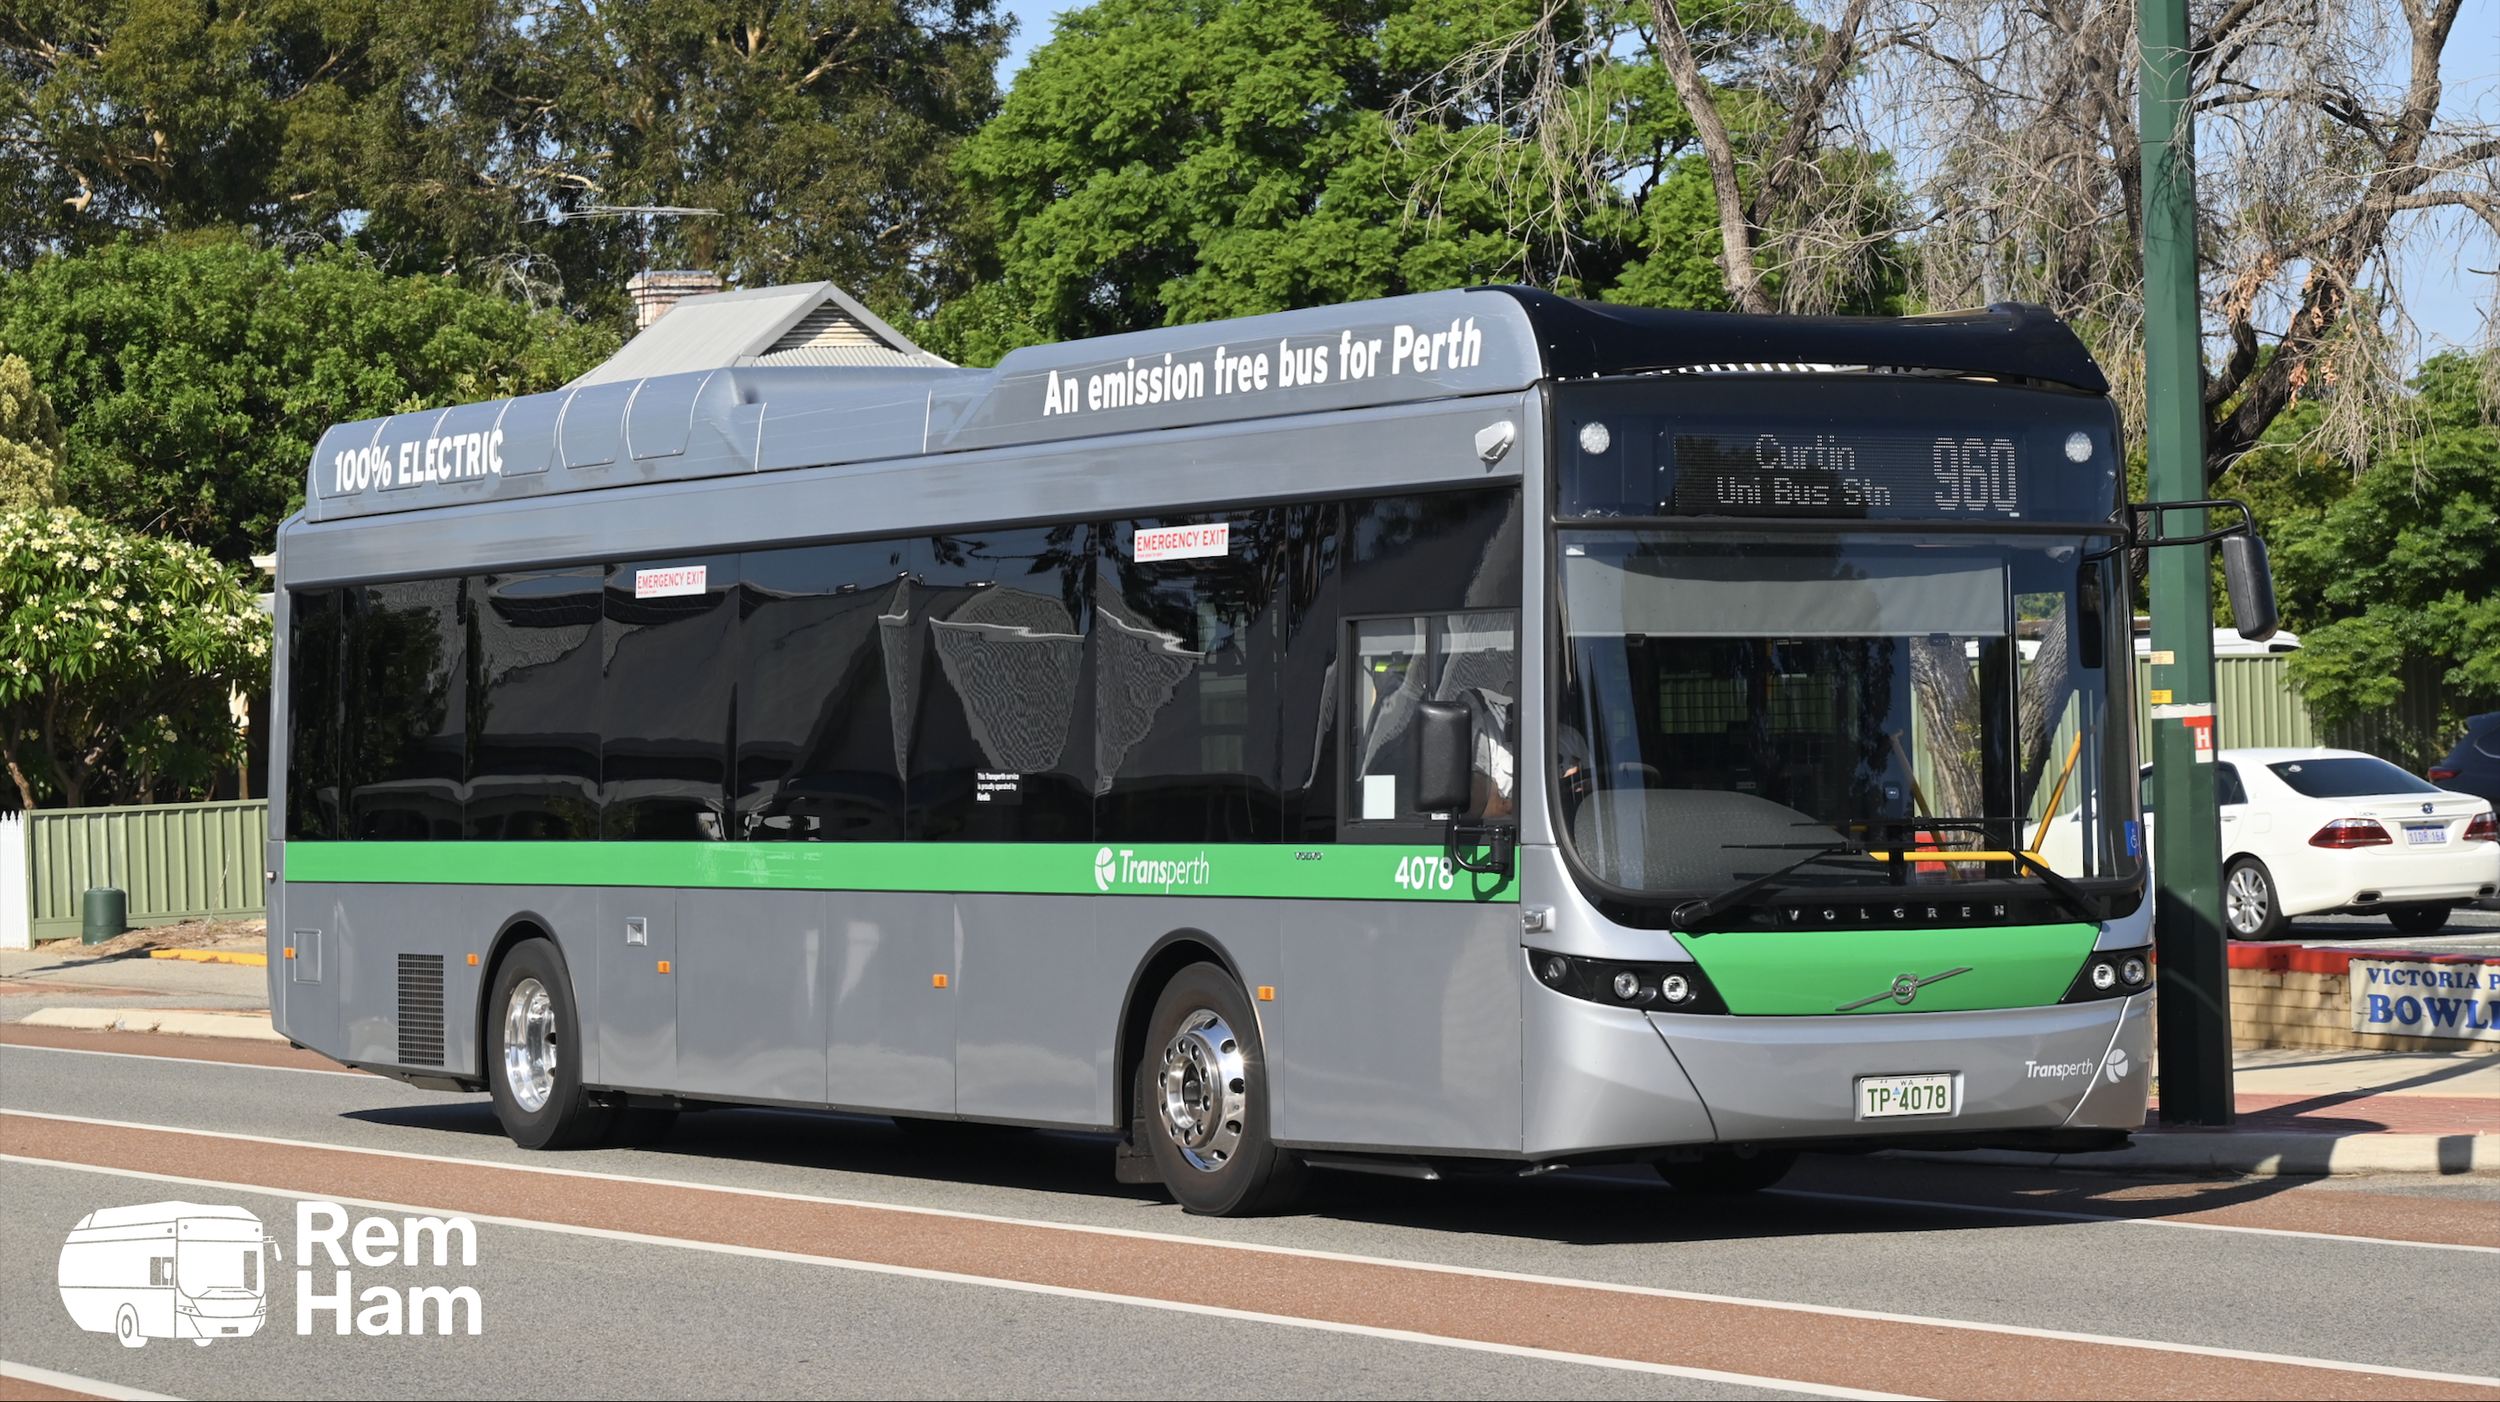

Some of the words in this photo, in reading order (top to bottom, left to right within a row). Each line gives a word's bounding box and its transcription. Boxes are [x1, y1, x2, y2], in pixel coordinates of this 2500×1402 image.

[1043, 370, 1079, 416] An
[1088, 353, 1204, 411] emission
[1214, 346, 1269, 396] free
[1279, 338, 1329, 388] bus
[1339, 330, 1382, 381] for
[1391, 316, 1482, 376] Perth
[334, 445, 392, 492] 100%
[398, 429, 504, 485] ELECTRIC
[1756, 433, 1855, 470] Curtin
[1933, 437, 2017, 511] 960
[1717, 476, 1761, 504] Uni
[1774, 477, 1830, 505] Bus
[1843, 478, 1891, 506] Stn
[1136, 531, 1200, 552] EMERGENCY
[1202, 529, 1227, 546] EXIT
[637, 572, 685, 589] EMERGENCY
[686, 571, 705, 585] EXIT
[2196, 727, 2210, 748] H
[1119, 850, 1210, 894] Transperth
[1394, 856, 1454, 890] 4078
[1789, 905, 2005, 921] VOLGREN
[2366, 967, 2482, 989] VICTORIA
[2025, 1058, 2093, 1081] Transperth
